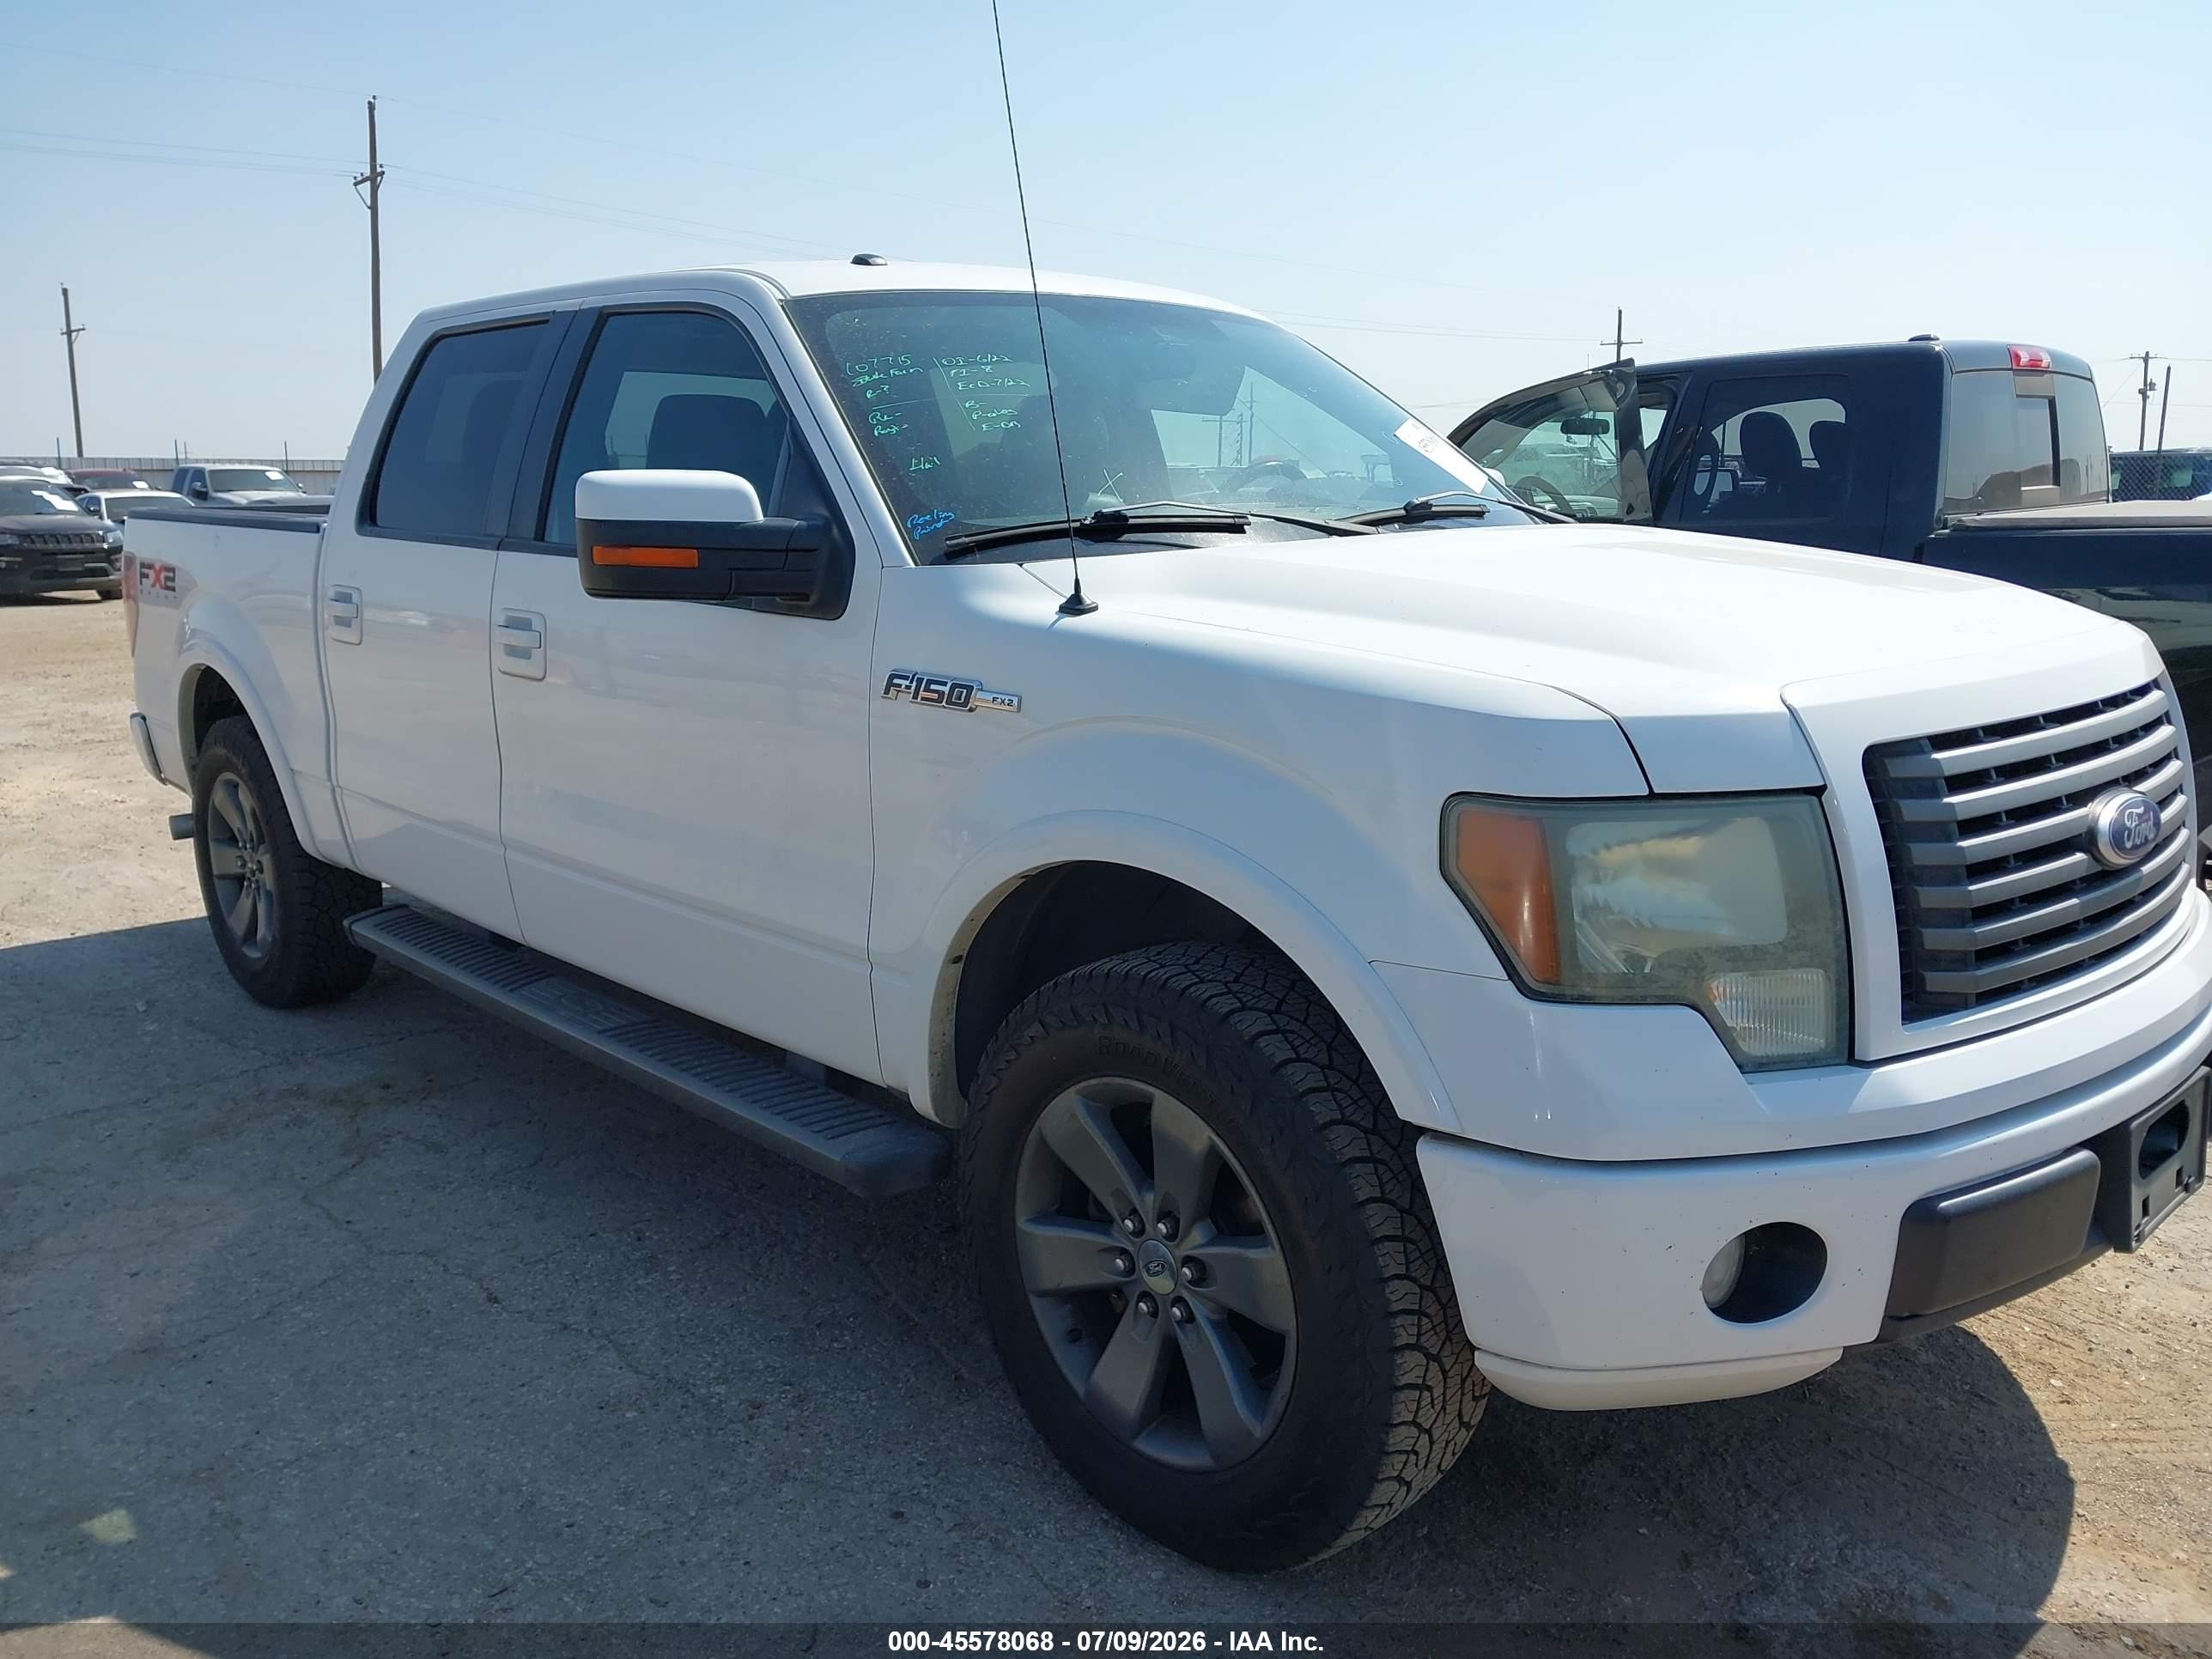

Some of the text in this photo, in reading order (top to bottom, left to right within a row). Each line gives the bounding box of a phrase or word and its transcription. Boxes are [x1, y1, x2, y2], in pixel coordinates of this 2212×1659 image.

[138, 562, 177, 592] FX2
[991, 696, 1016, 708] FX2
[2123, 805, 2157, 850] Ford
